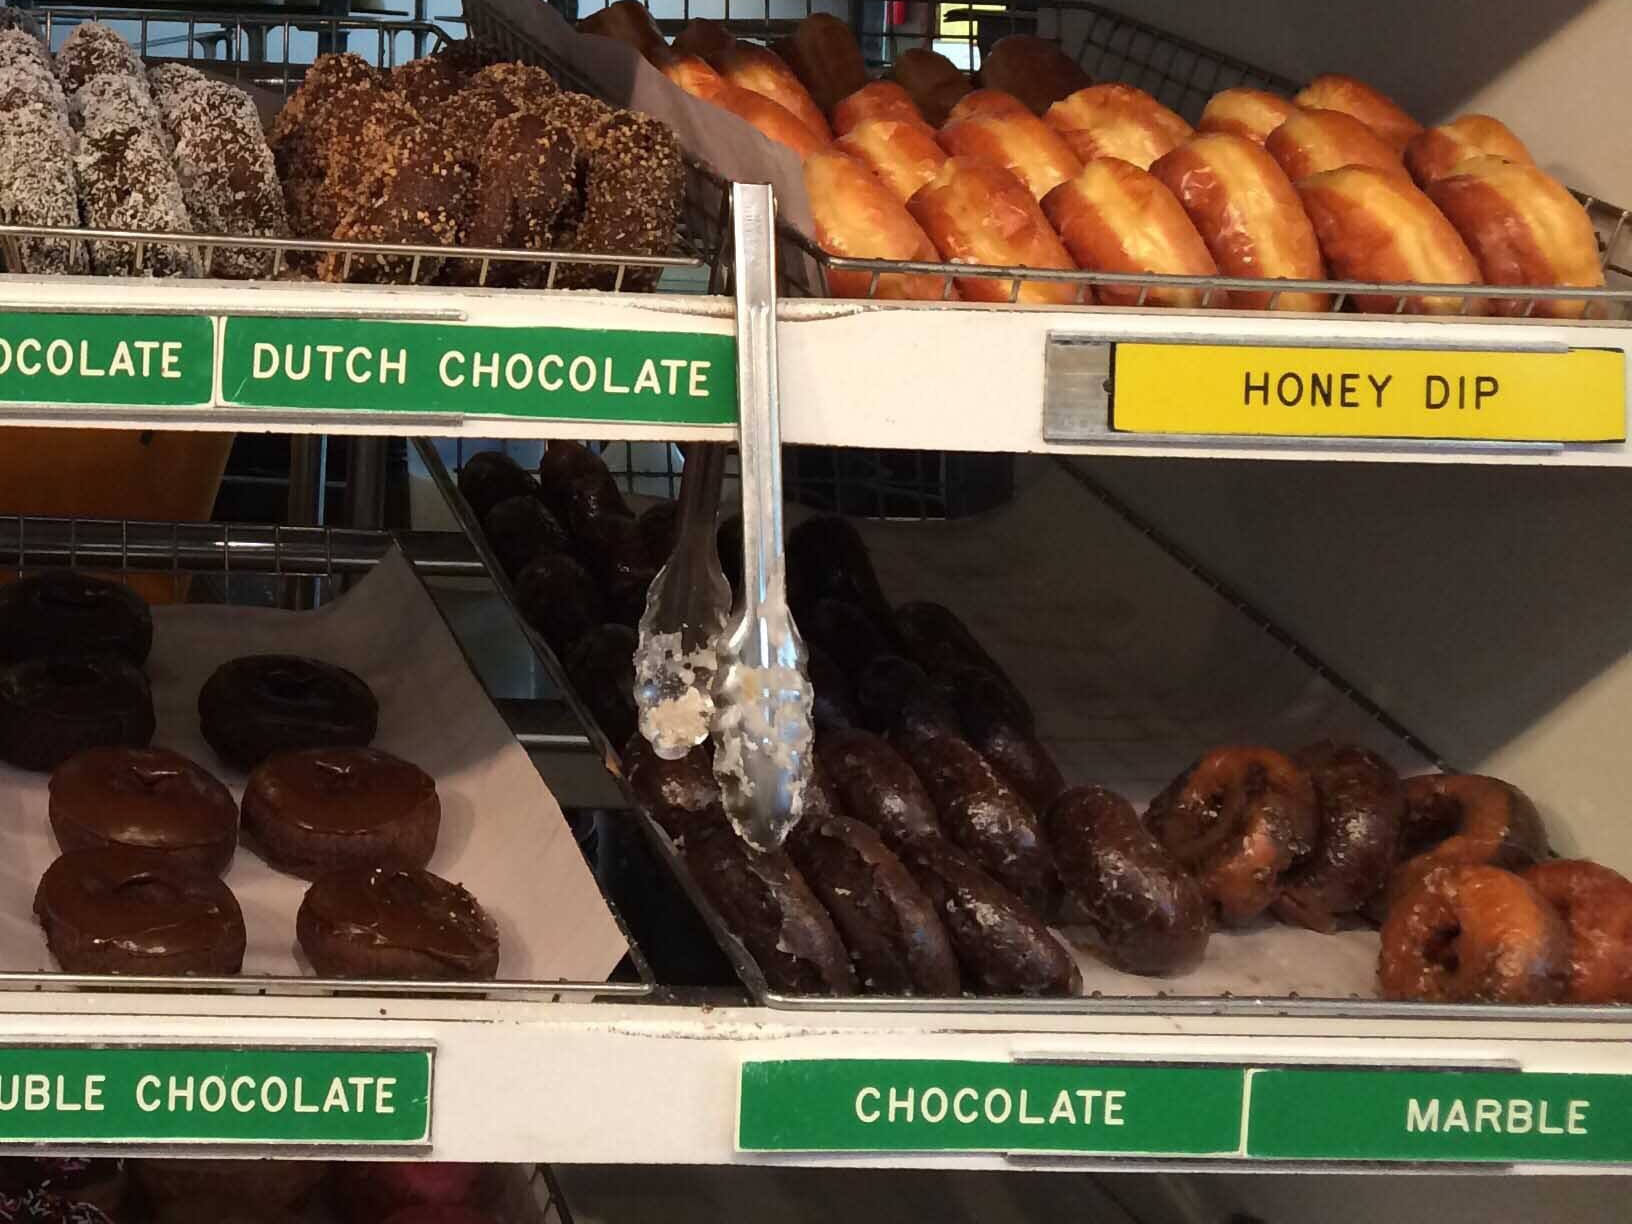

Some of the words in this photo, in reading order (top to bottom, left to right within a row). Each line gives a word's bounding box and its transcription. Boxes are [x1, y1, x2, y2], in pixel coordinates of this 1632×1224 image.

[251, 341, 408, 386] DUTCH
[437, 349, 713, 398] CHOCOLATE
[1243, 371, 1394, 410] HONEY
[1424, 374, 1501, 411] DIP
[134, 1073, 398, 1115] CHOCOLATE
[854, 1085, 1128, 1127] CHOCOLATE
[1405, 1097, 1591, 1136] MARBLE
